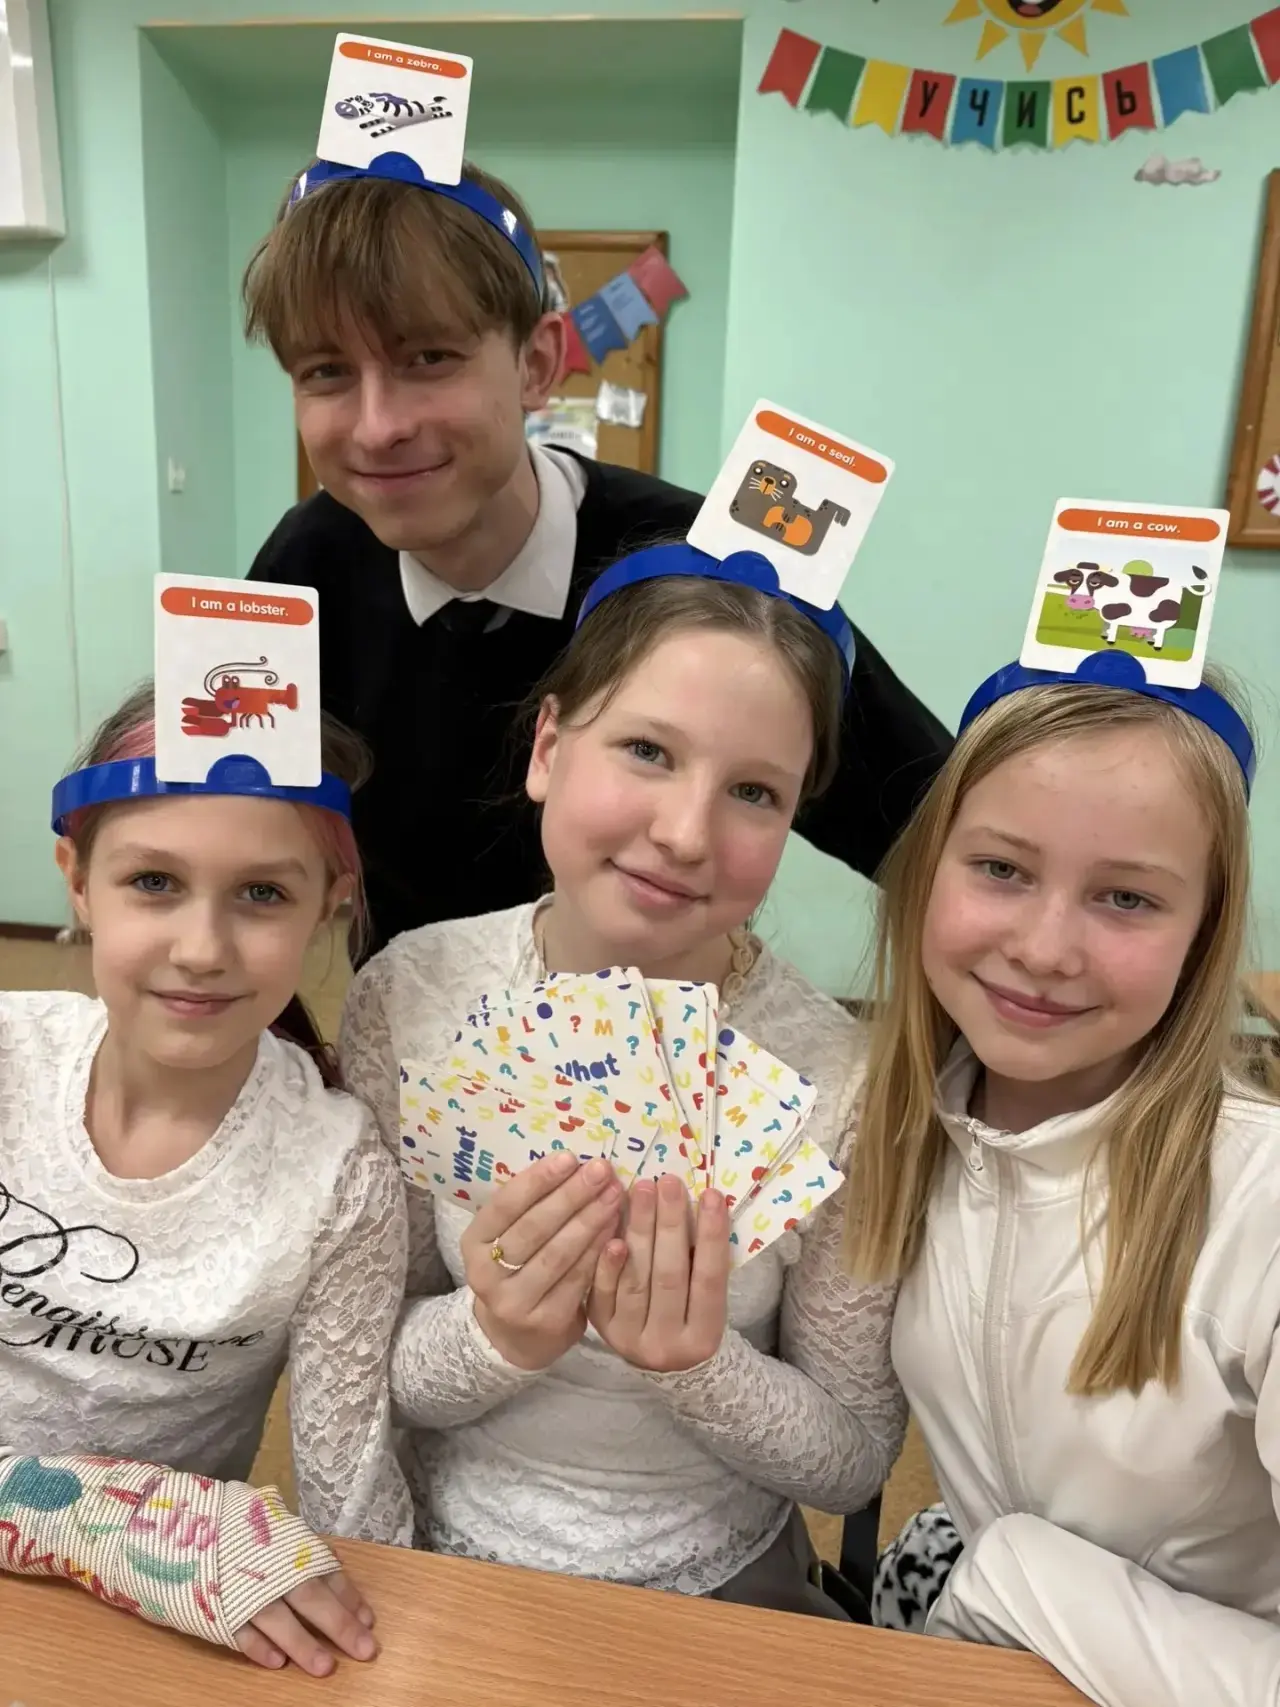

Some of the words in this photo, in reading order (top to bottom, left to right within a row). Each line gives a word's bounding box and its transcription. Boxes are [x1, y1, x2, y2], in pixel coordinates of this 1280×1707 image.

[367, 49, 372, 57] I
[374, 52, 393, 61] am
[395, 56, 404, 64] a
[406, 58, 442, 71] zebra.
[918, 80, 1137, 128] УЧИСЬ
[788, 427, 795, 436] I
[795, 432, 816, 447] am
[818, 443, 828, 452] a
[828, 448, 857, 467] seal.
[1097, 516, 1103, 526] I
[1105, 519, 1129, 529] am
[1132, 521, 1143, 530] a
[1146, 522, 1181, 533] cow.
[191, 596, 196, 608] I
[200, 599, 222, 610] am
[226, 602, 236, 611] a
[239, 600, 289, 616] lobster.
[453, 1126, 478, 1182] What
